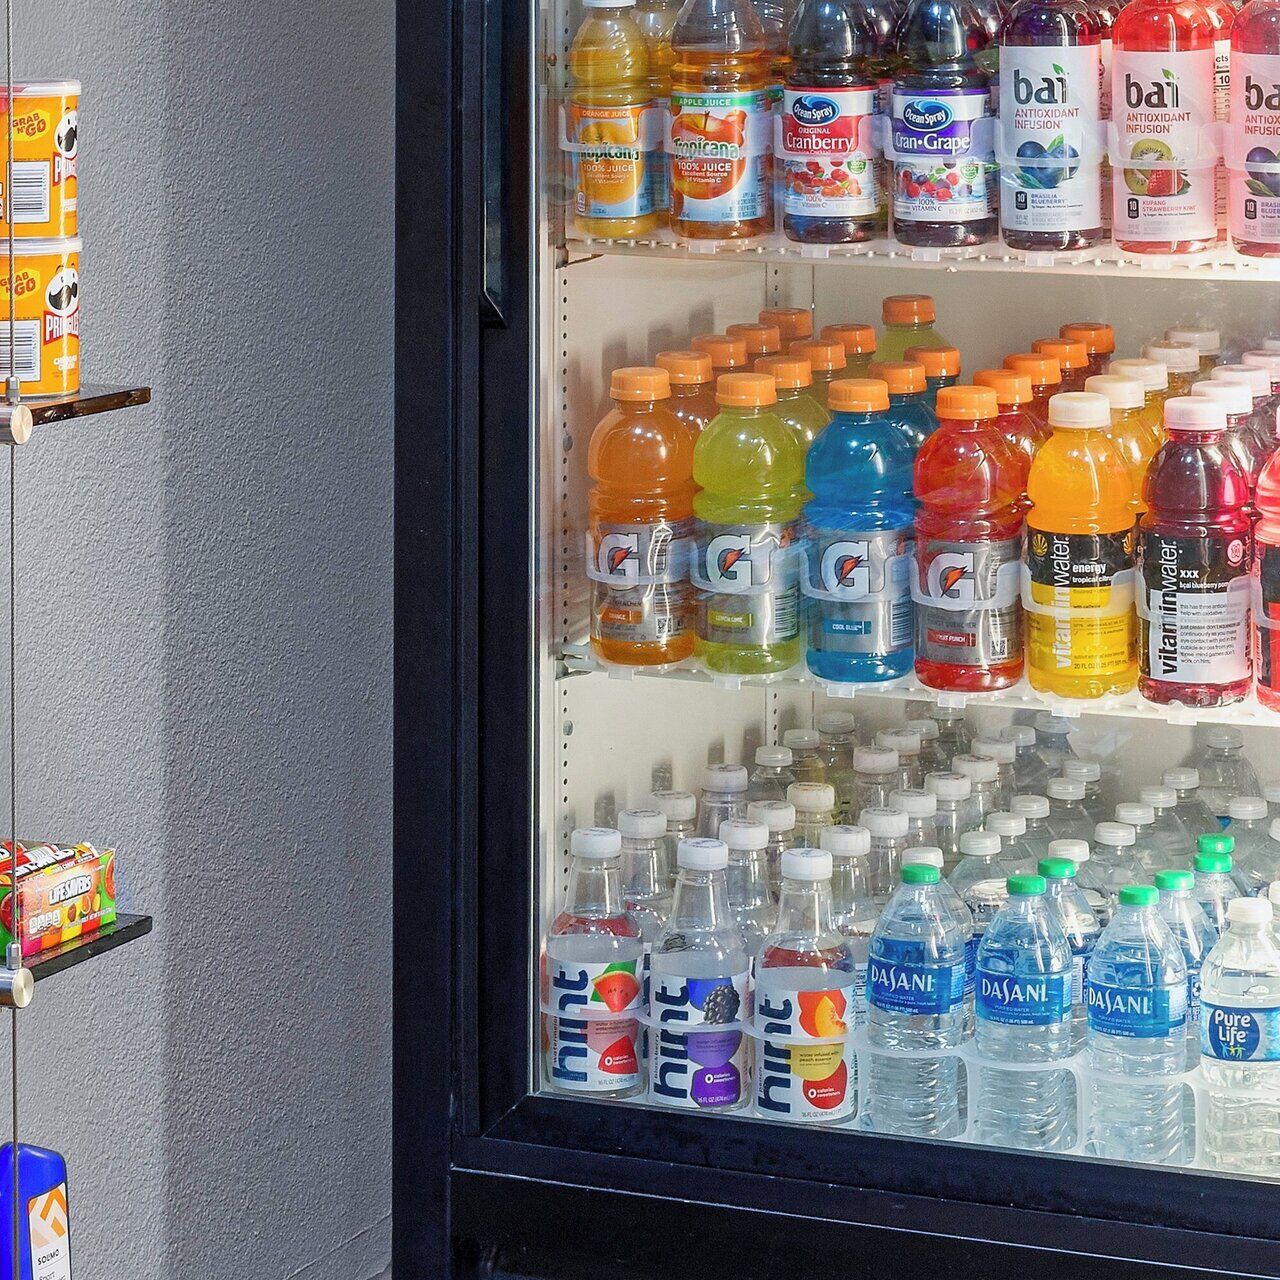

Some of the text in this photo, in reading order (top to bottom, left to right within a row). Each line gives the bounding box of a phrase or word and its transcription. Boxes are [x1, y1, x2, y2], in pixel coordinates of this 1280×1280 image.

[1014, 63, 1069, 106] bai
[1125, 69, 1180, 109] bai
[679, 98, 731, 106] APPLE JUICE
[1014, 108, 1079, 119] ANTIOXIDANT
[1126, 112, 1191, 123] ANTIOXIDANT
[798, 127, 831, 135] ORIGINAL
[1014, 120, 1062, 130] INFUSION
[1126, 124, 1172, 135] INFUSION
[786, 132, 853, 153] Cranberry
[677, 162, 732, 171] 100% JUICE
[1072, 563, 1106, 575] energy
[1054, 535, 1073, 669] vitaminwater
[1162, 540, 1178, 675] vitaminwater
[871, 964, 934, 997] DASANI
[981, 976, 1048, 1005] DASANI
[1088, 986, 1152, 1017] DASANI
[552, 969, 589, 1083] hint
[1214, 1008, 1252, 1030] Pure
[653, 984, 691, 1099] hint
[1219, 1025, 1248, 1044] Life
[758, 996, 792, 1114] hint
